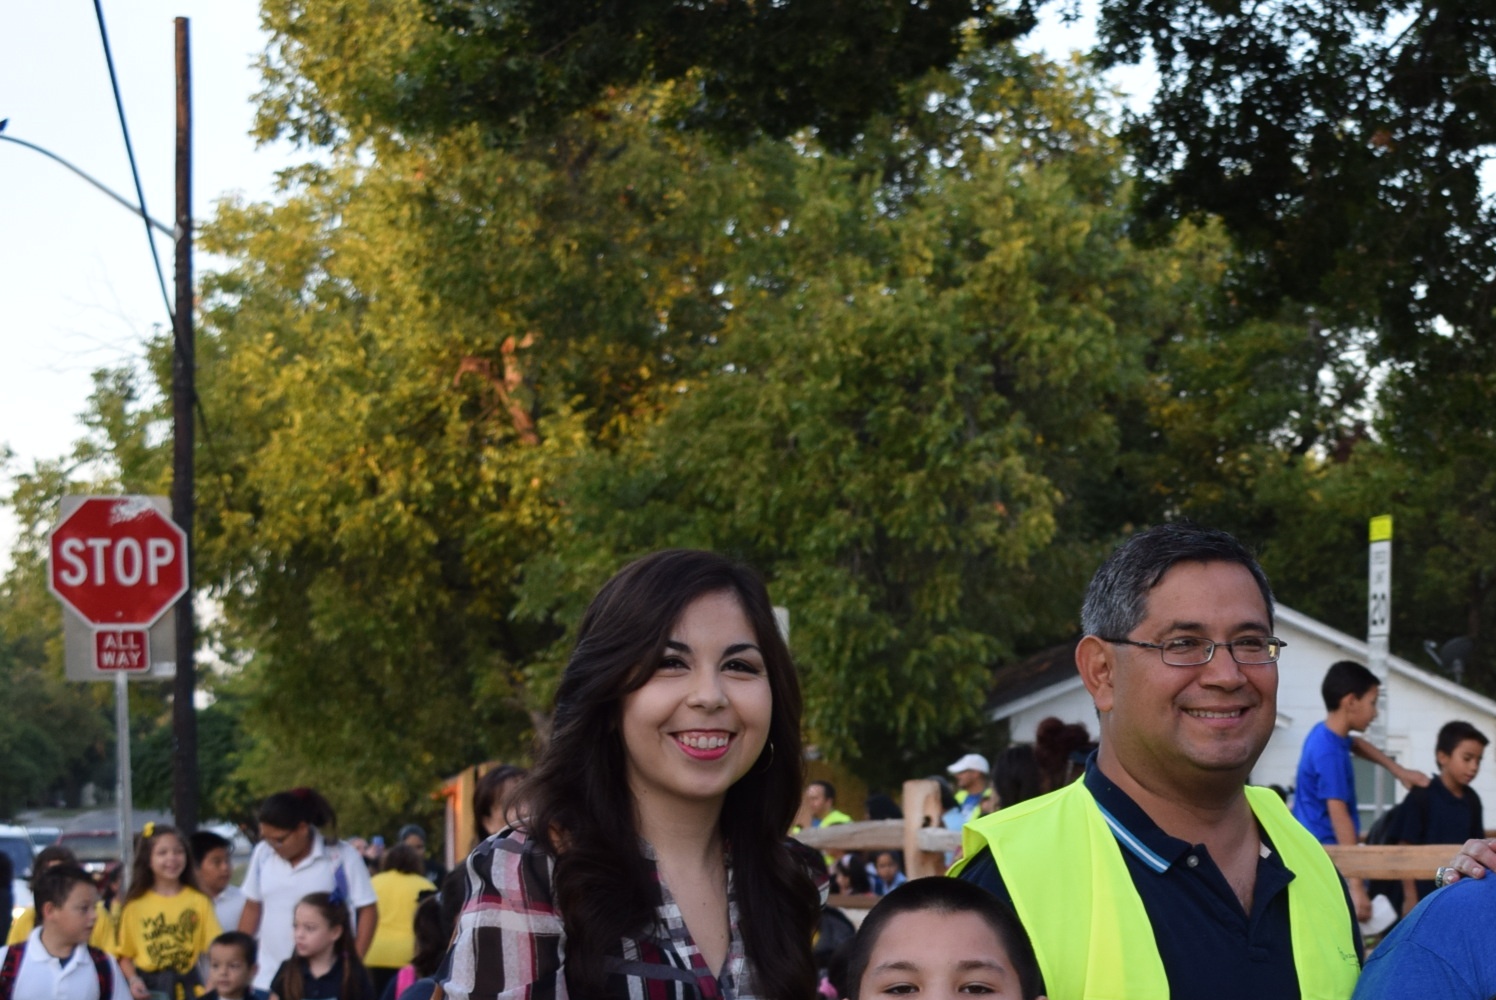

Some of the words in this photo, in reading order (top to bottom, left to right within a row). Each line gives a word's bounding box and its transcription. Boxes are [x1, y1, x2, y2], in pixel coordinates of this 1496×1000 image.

[59, 536, 176, 587] STOP
[103, 634, 141, 650] ALL
[101, 651, 142, 667] WAY
